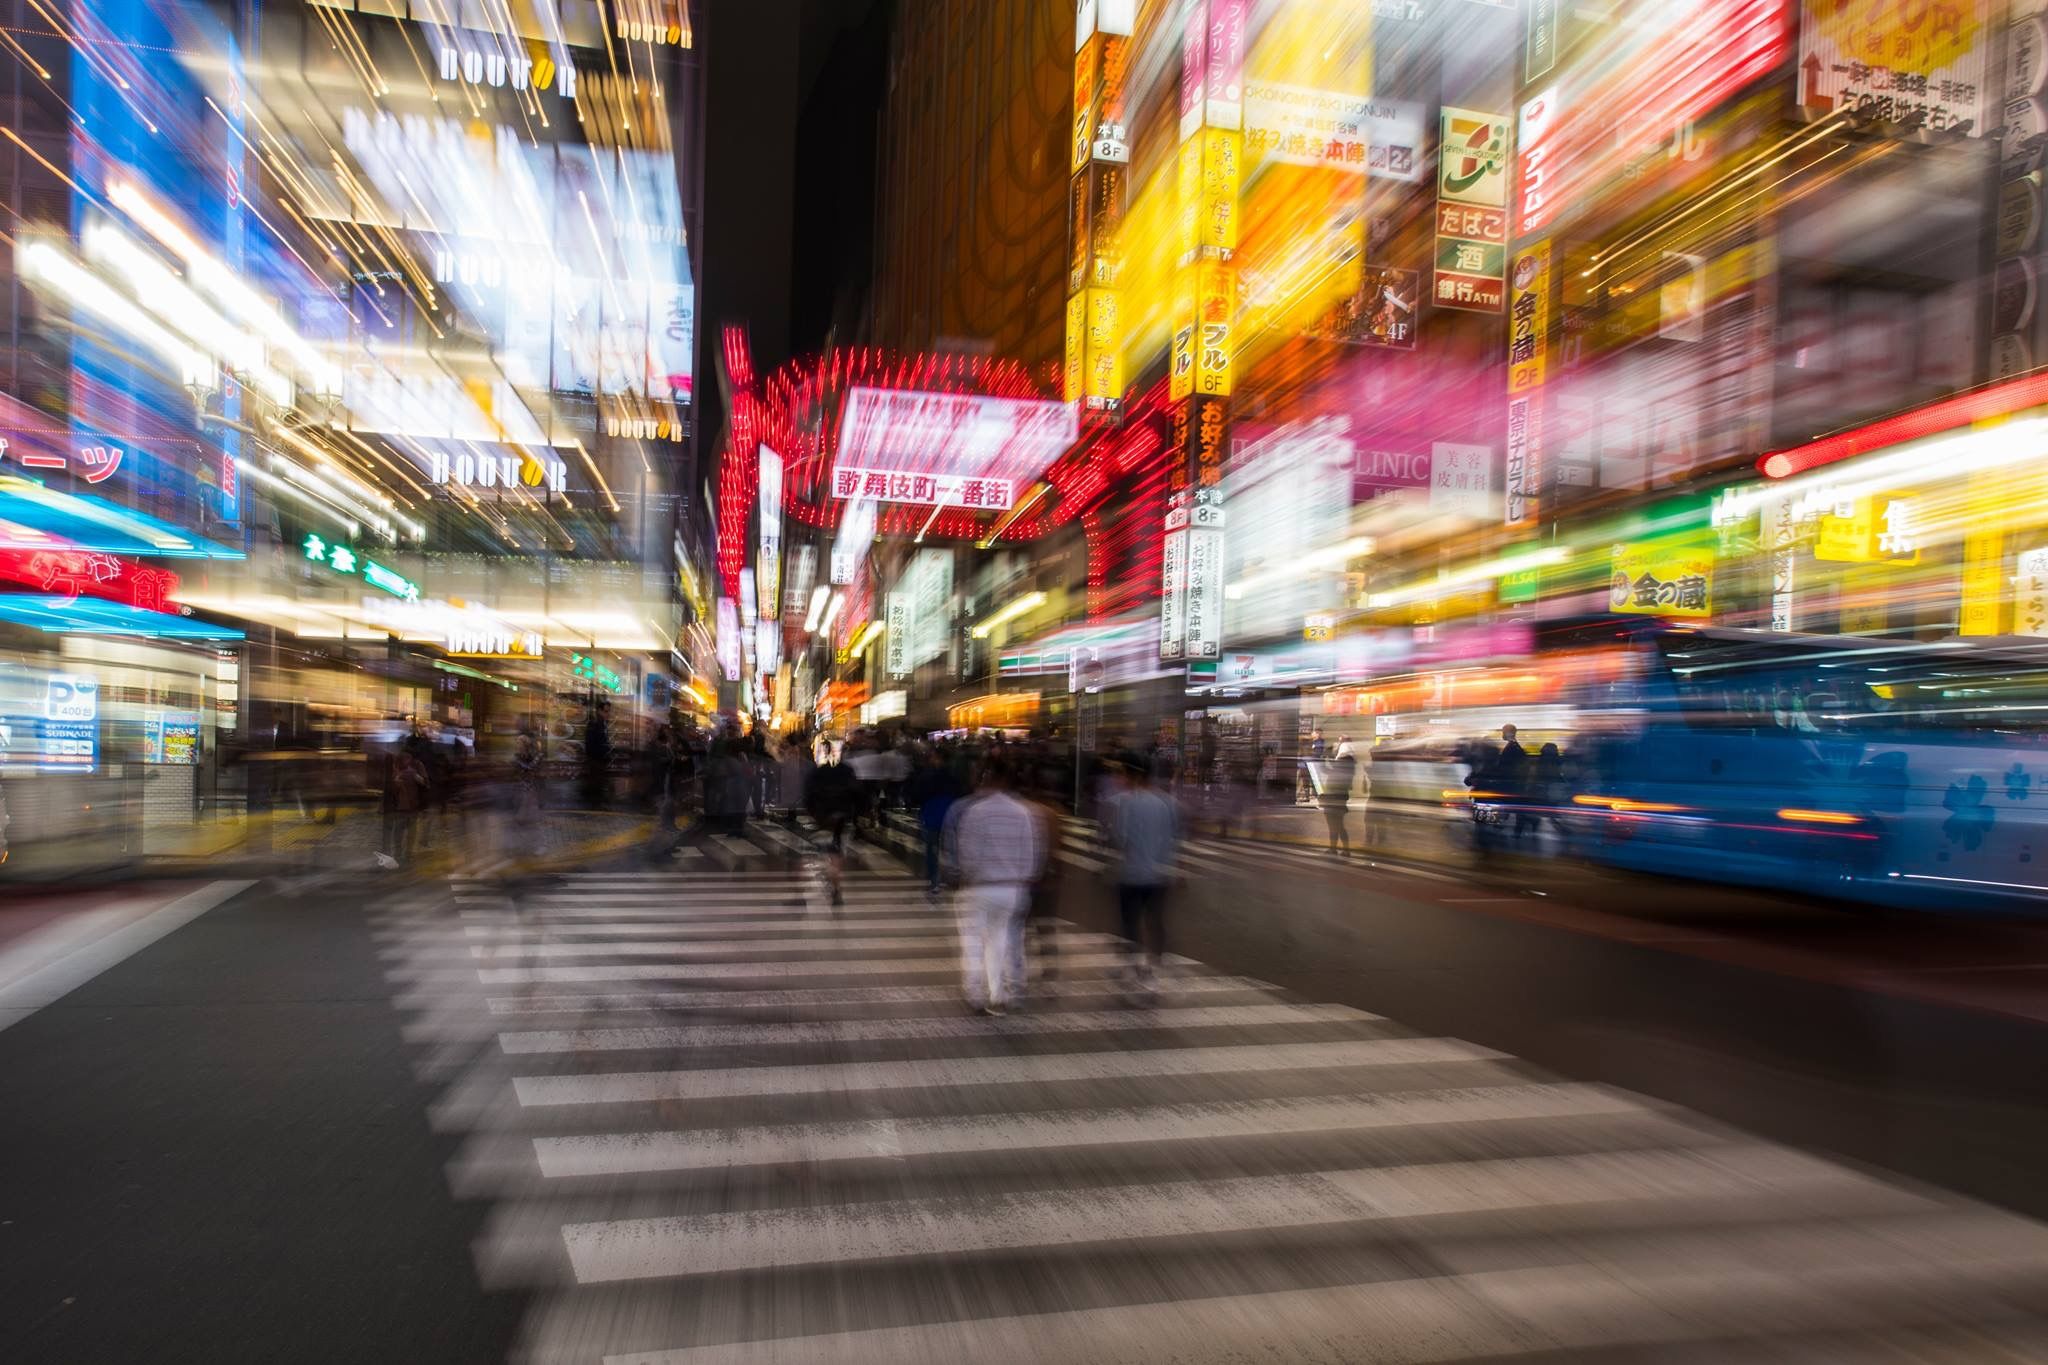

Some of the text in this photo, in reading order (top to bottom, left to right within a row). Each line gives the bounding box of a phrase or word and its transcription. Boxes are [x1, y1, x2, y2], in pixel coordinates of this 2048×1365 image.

[617, 19, 692, 49] DOUTOR
[1209, 22, 1225, 97] クリニック
[440, 48, 577, 98] DOUTOR
[1344, 101, 1397, 121] HONJIN
[1101, 142, 1121, 158] 8F
[1524, 147, 1545, 216] アコム
[1441, 206, 1503, 239] たばこ
[1523, 212, 1543, 232] 3F
[1456, 244, 1485, 271] 酒
[1386, 323, 1408, 341] 4F
[1510, 291, 1538, 367] 金の蔵
[1204, 375, 1222, 392] 6F
[1514, 367, 1538, 388] 2F
[607, 417, 683, 443] DOUTOR
[432, 453, 567, 492] DOUTOR
[1336, 447, 1429, 481] CLINIC
[1508, 400, 1527, 522] 東京チカラめし
[836, 469, 1010, 507] 歌舞伎町一番街
[1437, 471, 1488, 491] 皮膚科
[1170, 511, 1184, 526] 8F
[1199, 508, 1218, 523] 8F
[1632, 571, 1707, 610] 金の蔵
[447, 631, 542, 657] DOUTOR
[1203, 642, 1218, 656] 2F
[48, 681, 74, 716] P
[45, 729, 95, 739] SUBNADE
